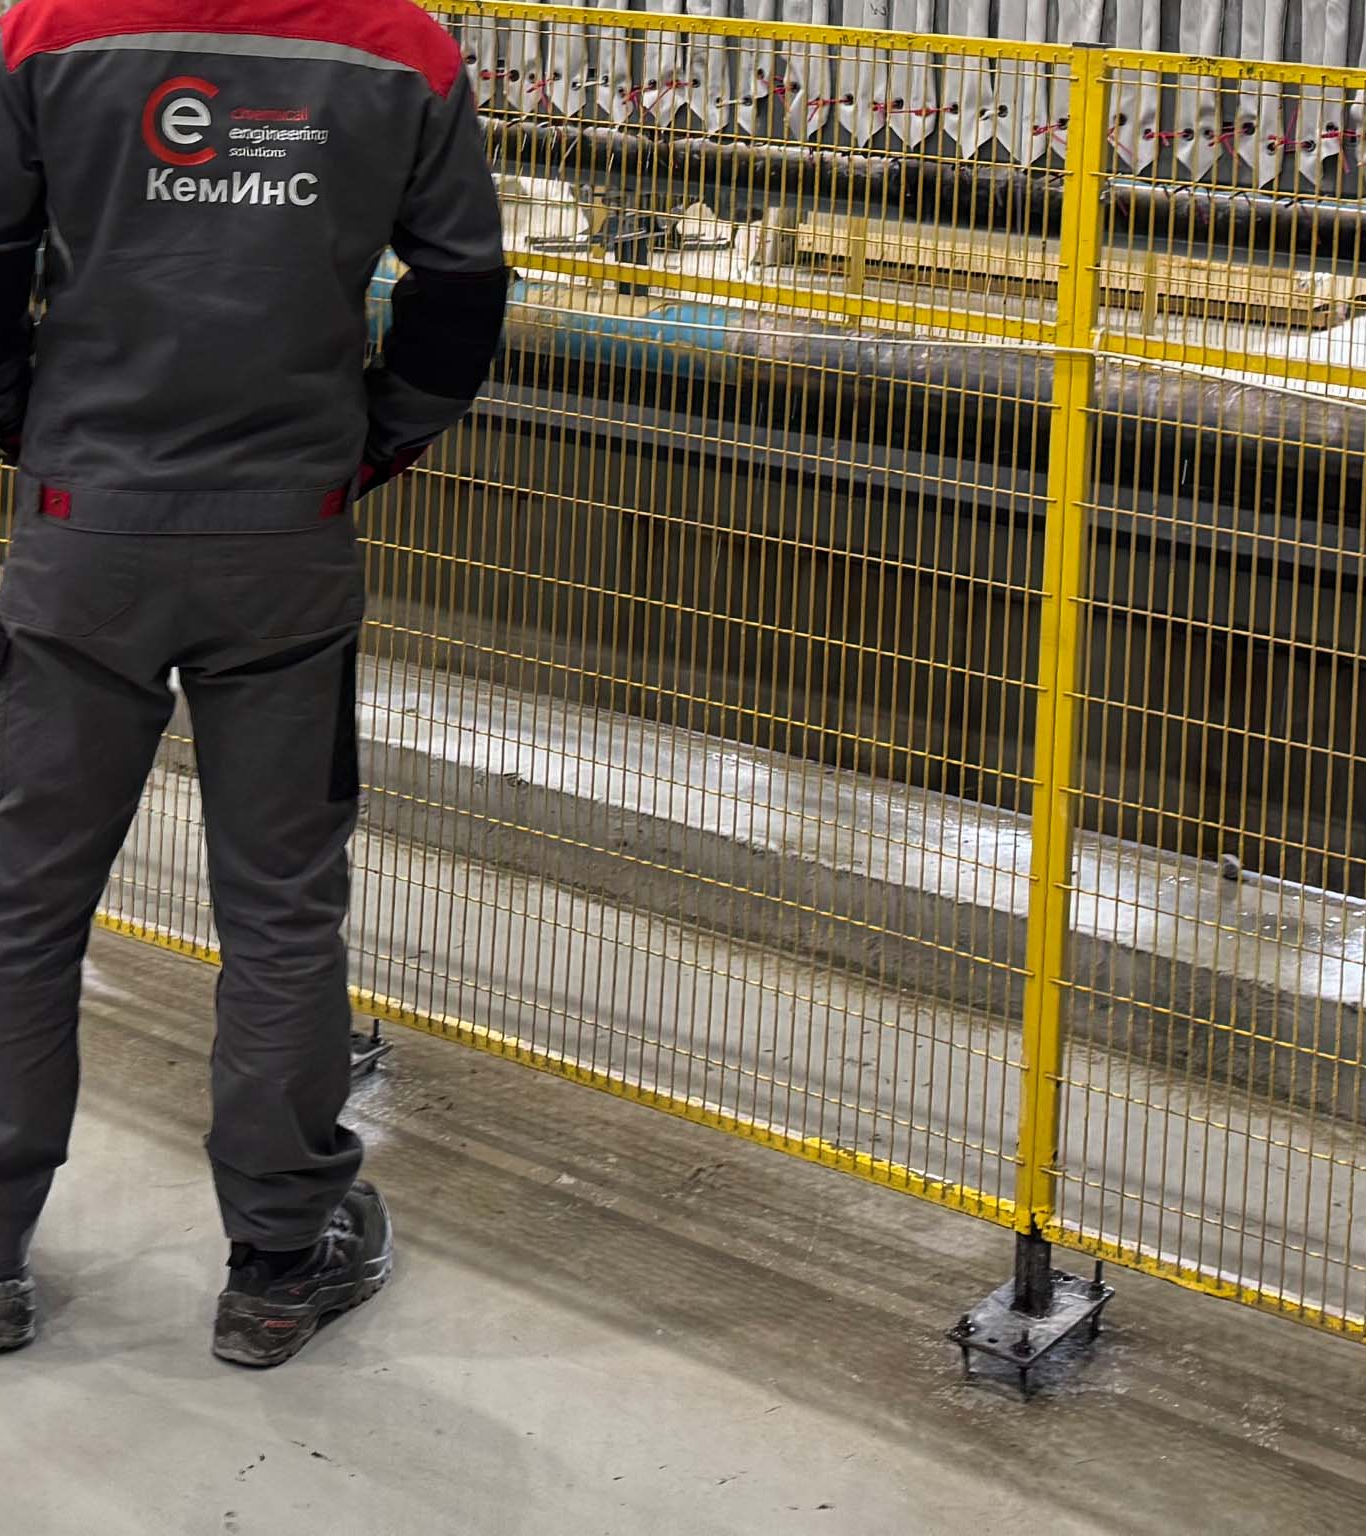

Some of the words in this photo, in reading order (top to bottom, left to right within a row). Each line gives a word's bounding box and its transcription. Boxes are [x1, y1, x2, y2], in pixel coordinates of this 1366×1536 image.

[228, 125, 329, 144] engineering
[228, 146, 287, 158] solutions
[145, 167, 319, 207] КемИнС
